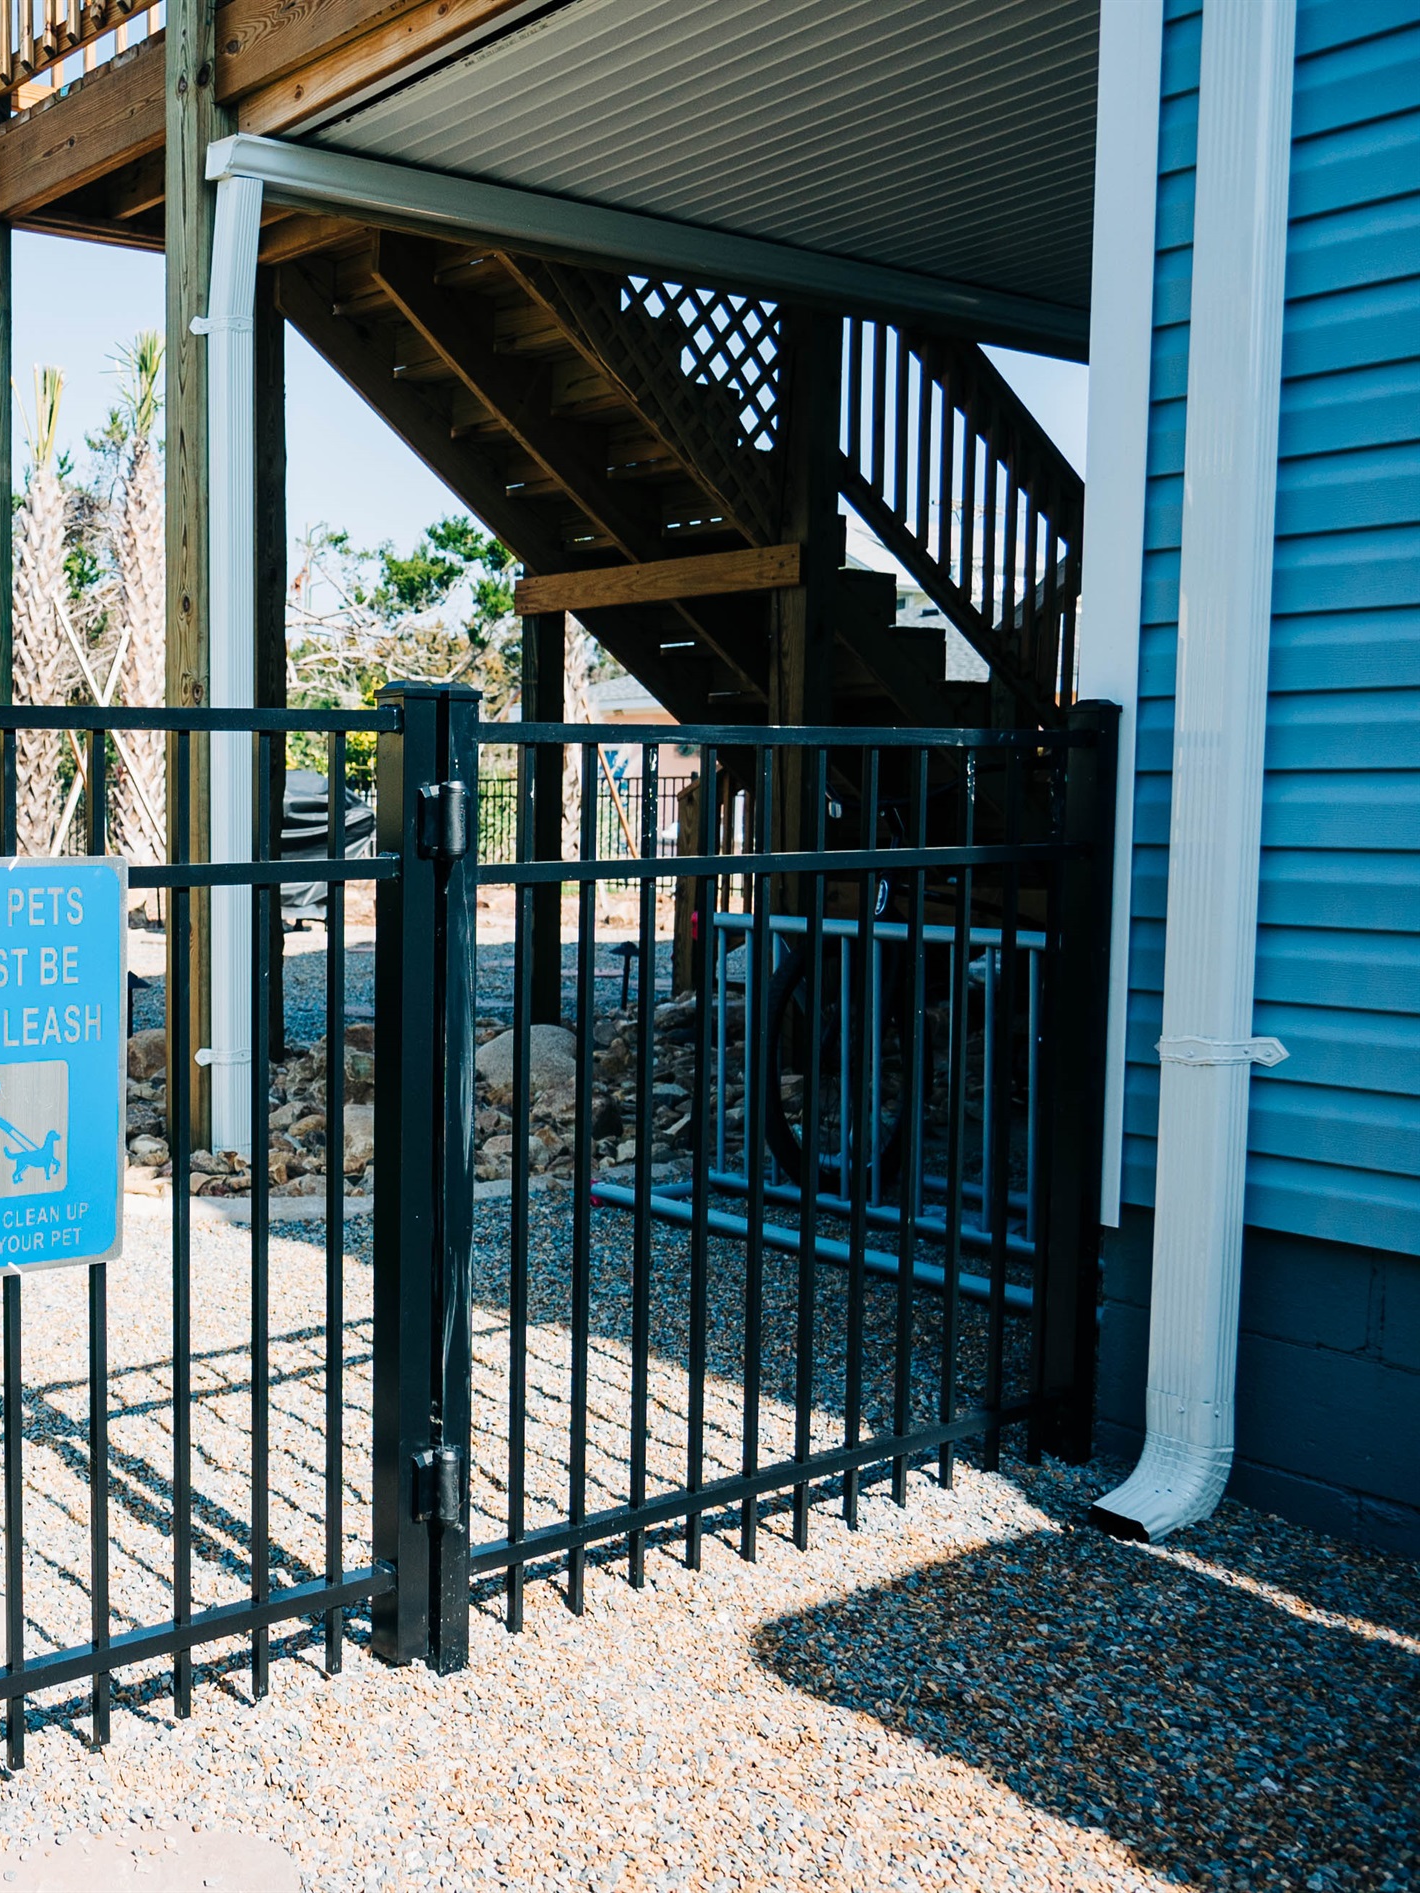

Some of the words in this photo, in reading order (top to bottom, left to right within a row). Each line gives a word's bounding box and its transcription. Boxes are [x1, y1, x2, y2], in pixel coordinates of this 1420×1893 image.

[7, 886, 84, 927] PETS
[40, 945, 79, 986] BE
[3, 1003, 102, 1047] LEASH
[3, 1207, 60, 1230] CLEAN
[66, 1202, 90, 1221] UP
[51, 1227, 82, 1247] PET
